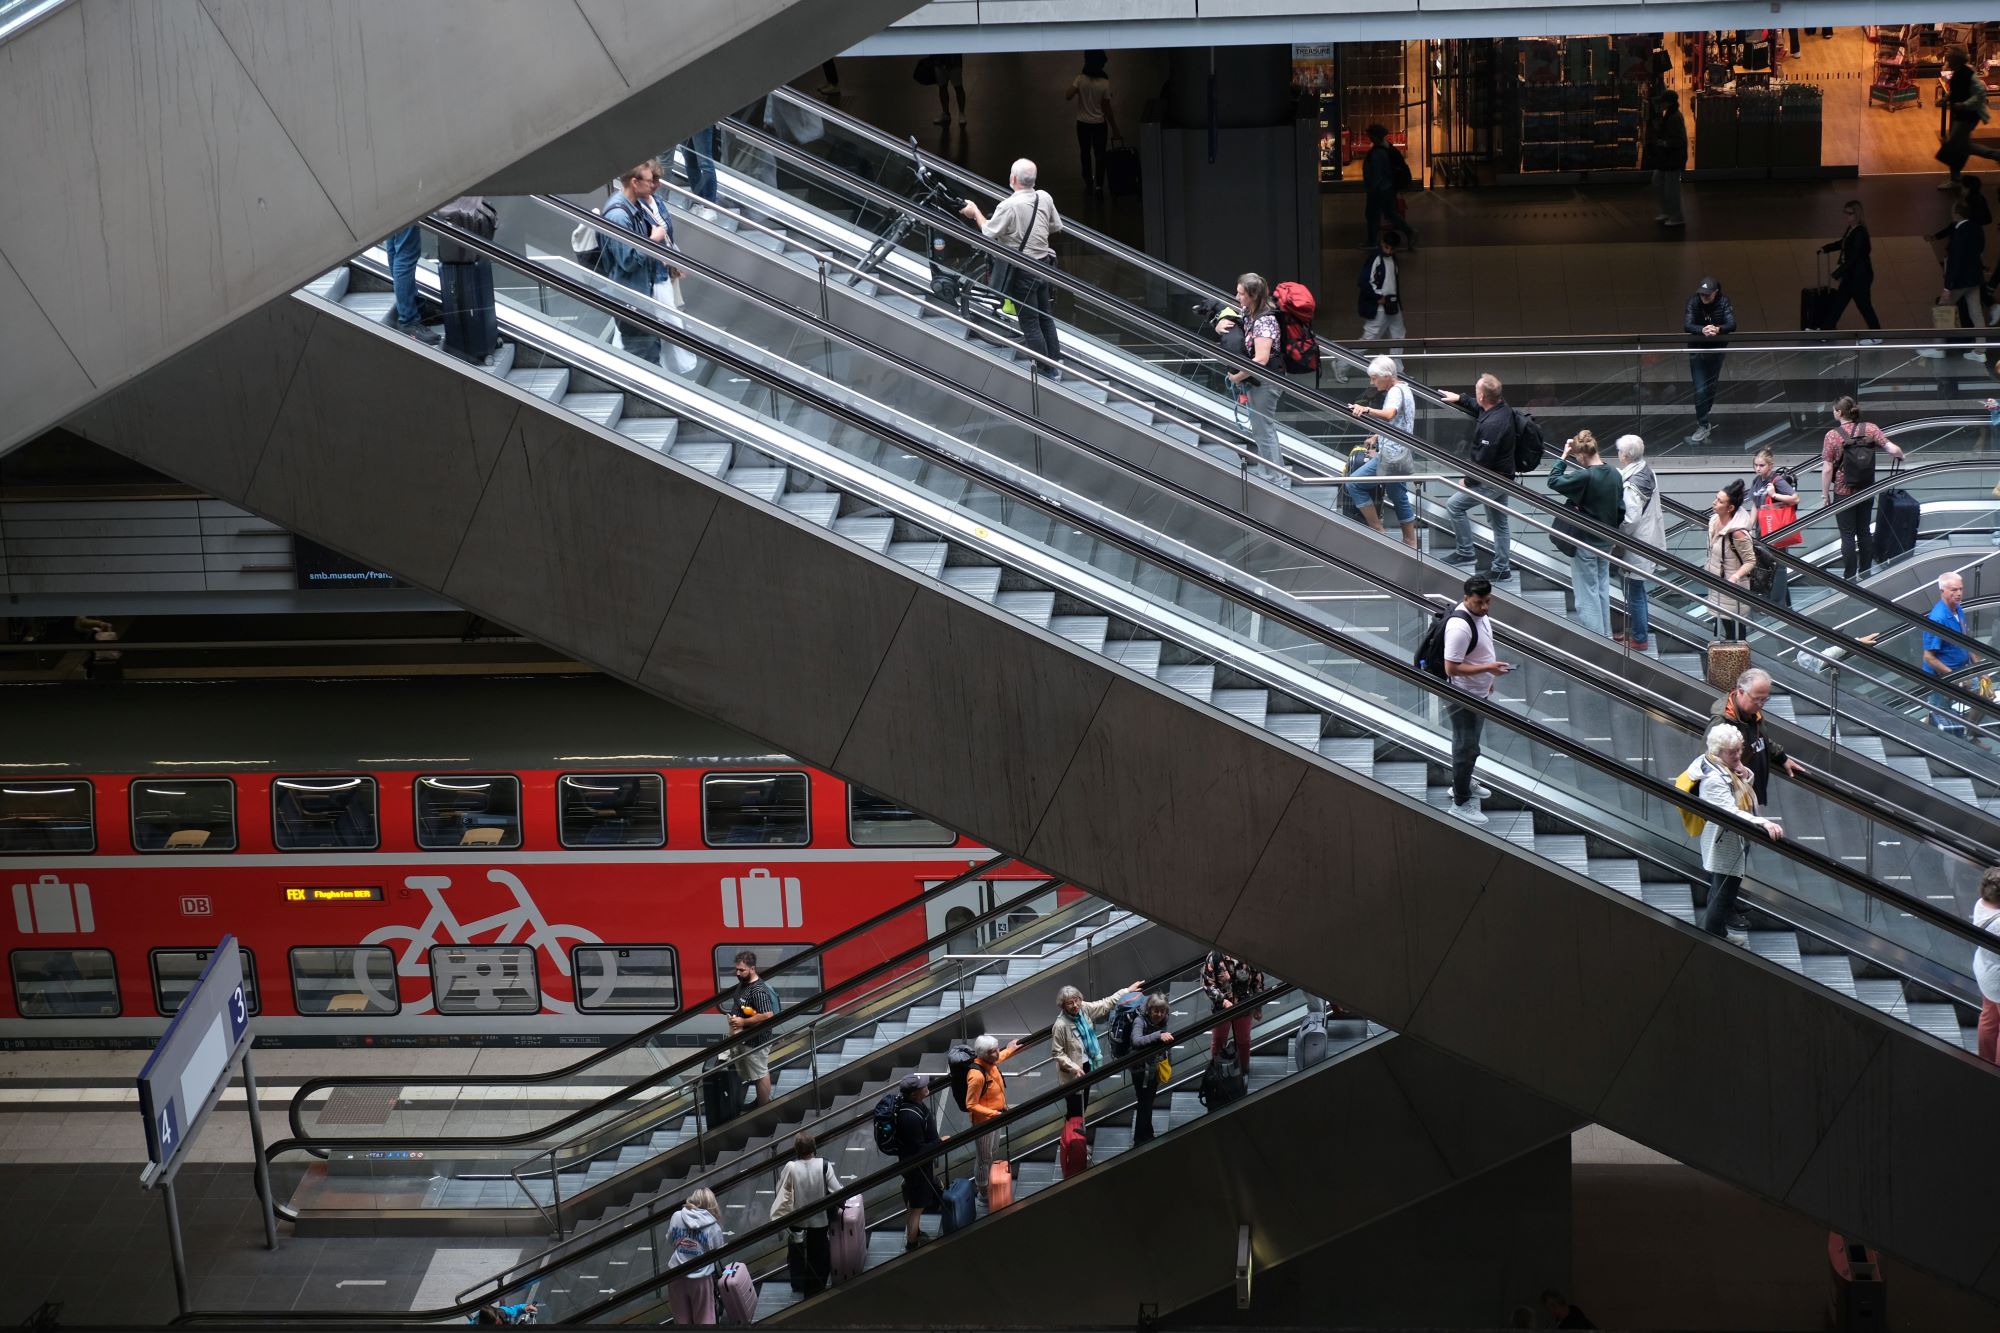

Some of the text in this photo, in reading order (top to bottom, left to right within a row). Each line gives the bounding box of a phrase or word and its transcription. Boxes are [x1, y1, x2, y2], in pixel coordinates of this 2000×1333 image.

[183, 898, 209, 913] DB
[287, 889, 305, 900] FEX
[315, 890, 353, 899] Flughafen
[234, 986, 244, 1024] 3
[162, 1108, 171, 1144] 4
